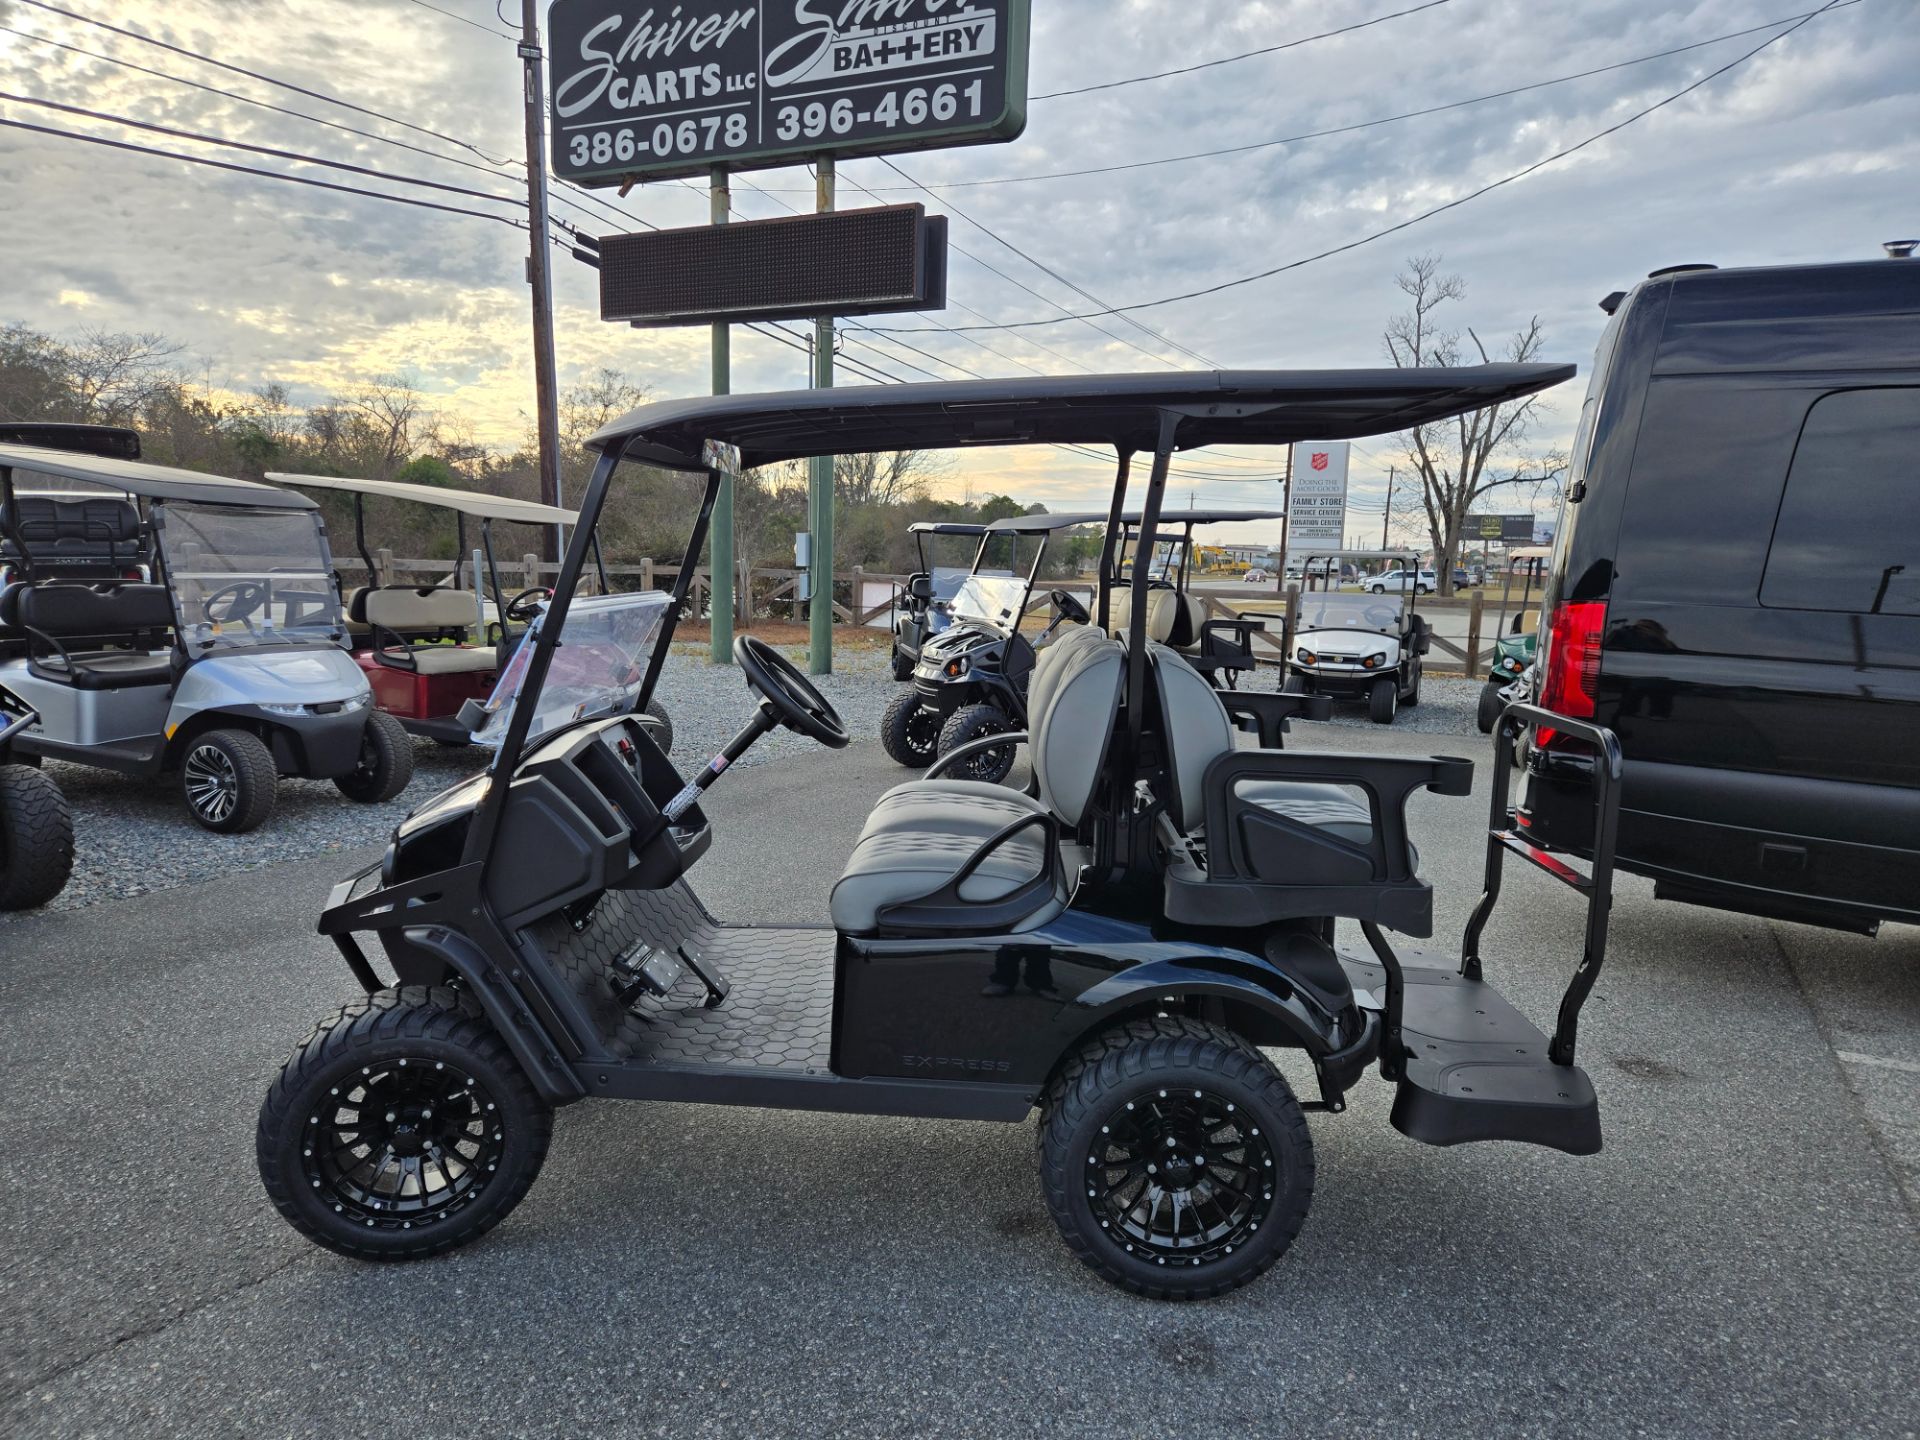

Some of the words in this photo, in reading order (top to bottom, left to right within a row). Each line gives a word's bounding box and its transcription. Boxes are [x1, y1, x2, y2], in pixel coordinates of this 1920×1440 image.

[556, 6, 756, 118] Shiver
[608, 63, 722, 110] CARTS
[726, 72, 756, 92] LLC
[776, 79, 982, 141] 396-4661
[569, 113, 748, 167] 386-0678
[1290, 519, 1319, 527] DONATION
[1320, 519, 1342, 527] CENTER
[1292, 498, 1317, 506] FAMILY
[1320, 498, 1343, 506] STORE
[902, 1055, 1011, 1072] EXPRESS
